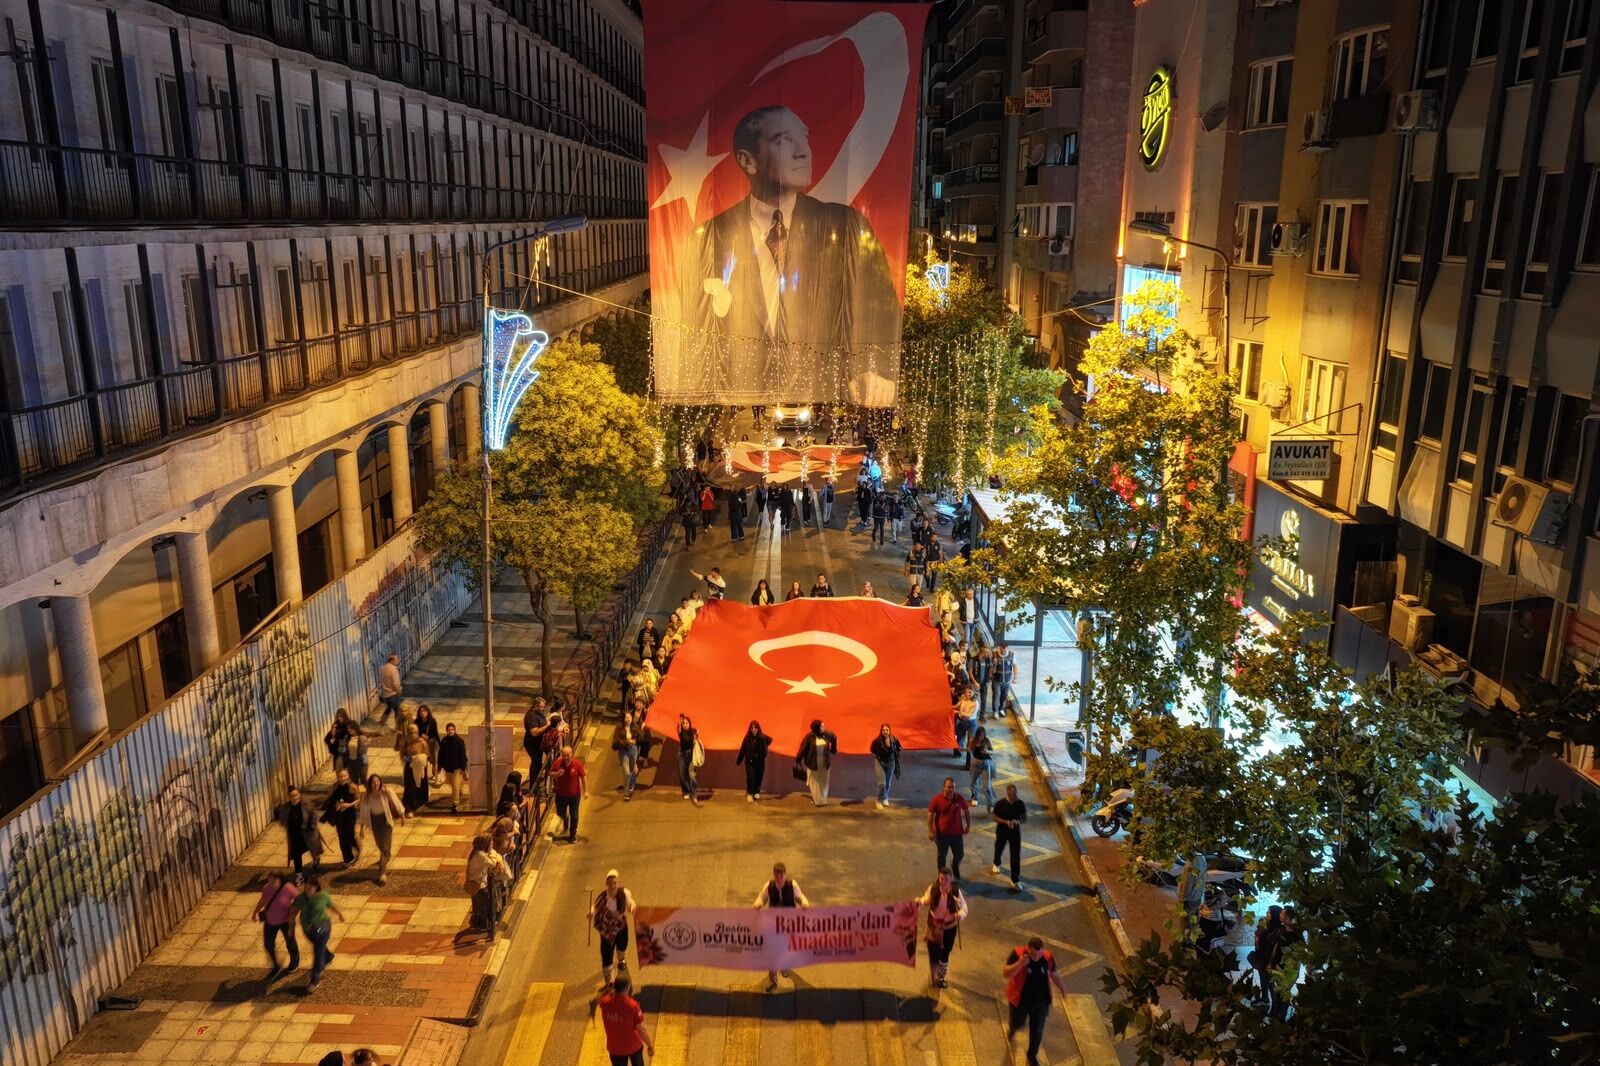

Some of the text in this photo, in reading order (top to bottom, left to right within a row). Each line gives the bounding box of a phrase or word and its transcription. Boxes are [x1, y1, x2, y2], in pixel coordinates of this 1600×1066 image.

[1274, 446, 1329, 459] AVUKAT
[775, 911, 891, 935] Balkanlar'dan
[703, 933, 764, 946] DUTLULU
[788, 931, 879, 951] Anadolu'ya
